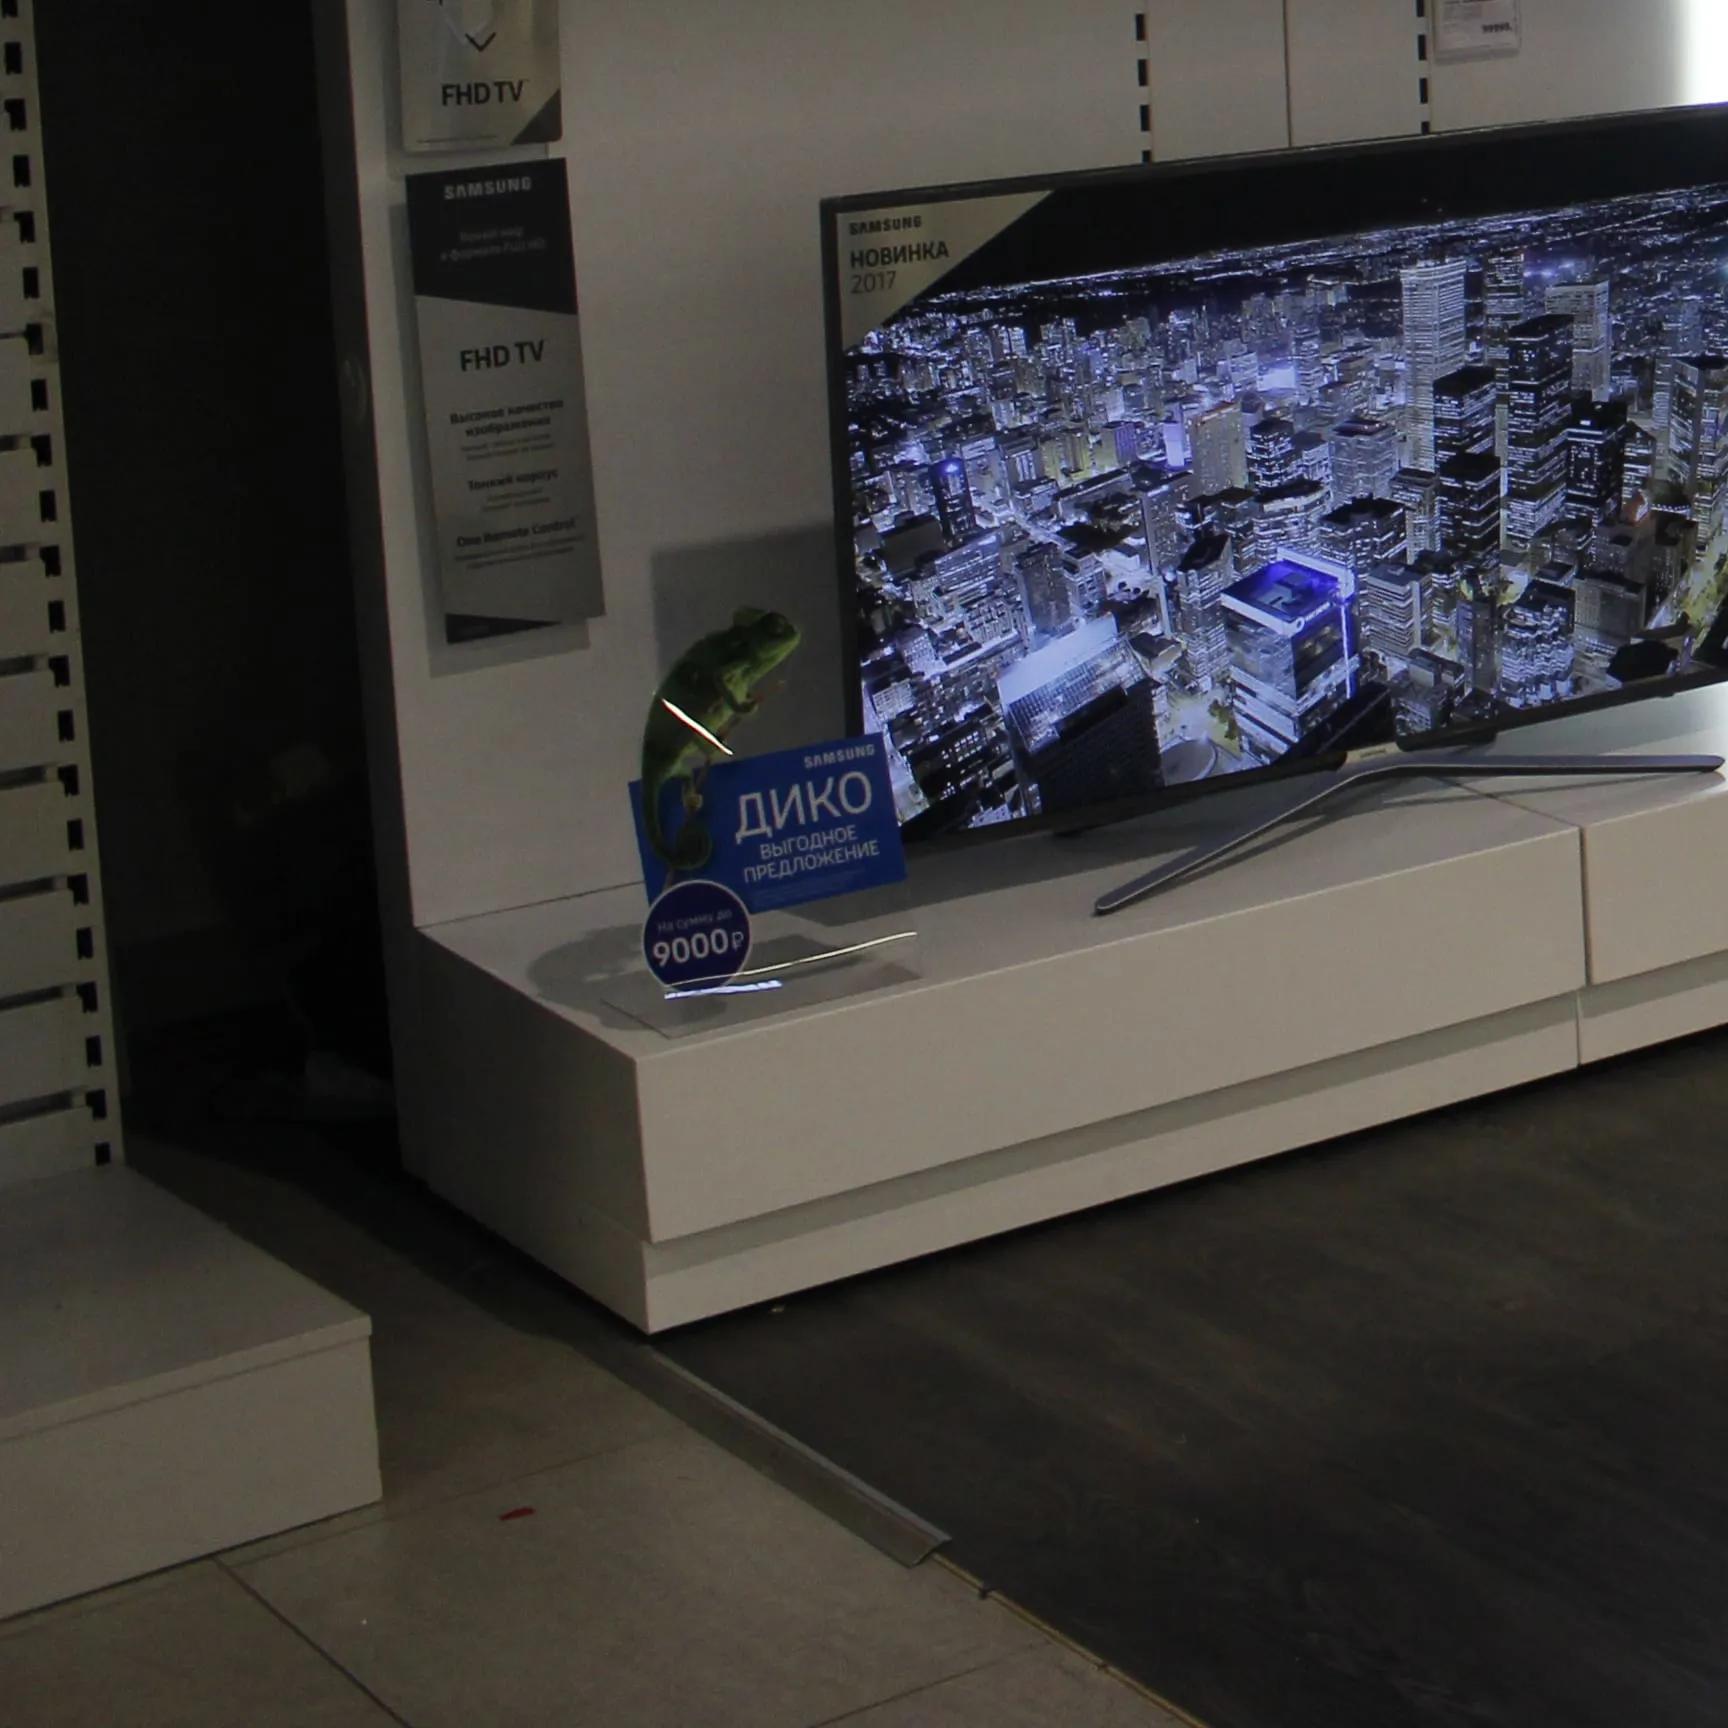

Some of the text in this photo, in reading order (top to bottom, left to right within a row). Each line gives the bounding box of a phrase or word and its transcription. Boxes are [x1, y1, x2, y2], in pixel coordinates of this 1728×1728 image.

[441, 80, 525, 106] FHD TV
[443, 176, 533, 201] SAMSUNG
[850, 215, 922, 236] SAMSUNG
[851, 240, 950, 269] НОВИНКА
[851, 271, 898, 295] 2017
[459, 337, 546, 372] FHD TV
[803, 743, 877, 769] SAMSUNG
[735, 771, 873, 845] ДИКО
[759, 824, 859, 862] ВЫГОДНОЕ
[743, 840, 881, 884] ПРЕДЛОЖЕНИЕ
